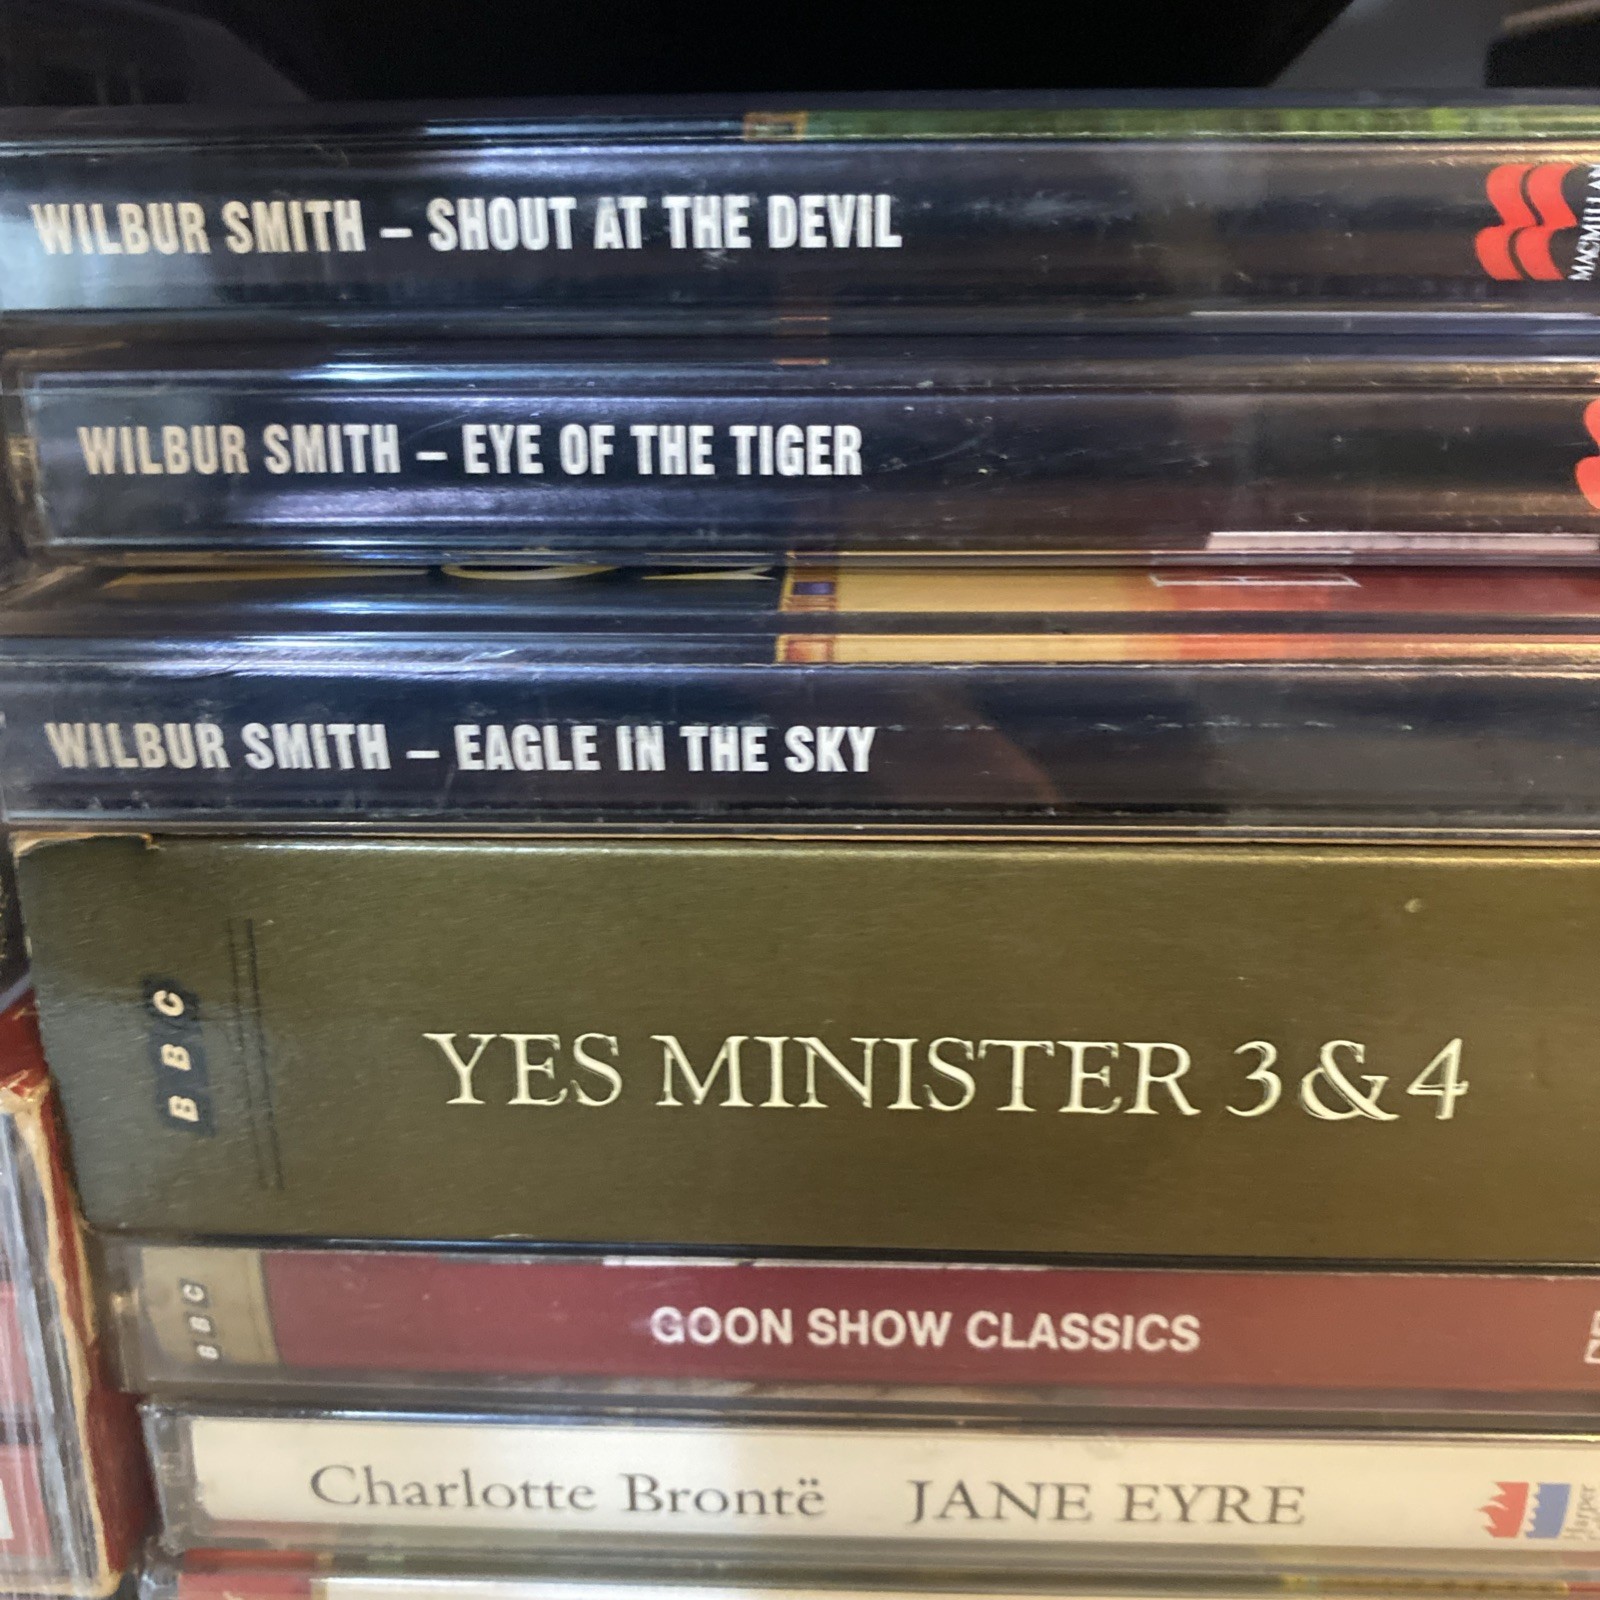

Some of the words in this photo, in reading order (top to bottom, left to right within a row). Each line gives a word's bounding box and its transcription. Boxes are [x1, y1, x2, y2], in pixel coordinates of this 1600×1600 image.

[31, 202, 211, 255] WILBUR
[221, 200, 366, 254] SMITH
[427, 196, 577, 252] SHOUT
[594, 195, 647, 250] AT
[661, 194, 752, 249] THE
[768, 193, 903, 249] DEVIL
[77, 425, 249, 475] WILBUR
[263, 424, 400, 475] SMITH
[462, 423, 544, 475] EYE
[559, 423, 615, 476] OF
[629, 424, 715, 476] THE
[729, 424, 863, 477] TIGER
[45, 722, 231, 769] WILBUR
[242, 722, 391, 770] SMITH
[454, 724, 601, 772] EAGLE
[616, 725, 666, 772] IN
[679, 725, 769, 772] THE
[784, 725, 877, 773] SKY
[422, 1032, 622, 1107] YES
[650, 1034, 1201, 1116] MINISTER
[649, 1305, 793, 1346] GOON
[807, 1308, 952, 1348] SHOW
[966, 1310, 1201, 1353] CLASSICS
[310, 1465, 595, 1511] Charlotte
[622, 1473, 826, 1515] Brontë
[907, 1480, 1093, 1525] JANE
[1117, 1484, 1306, 1526] EYRE
